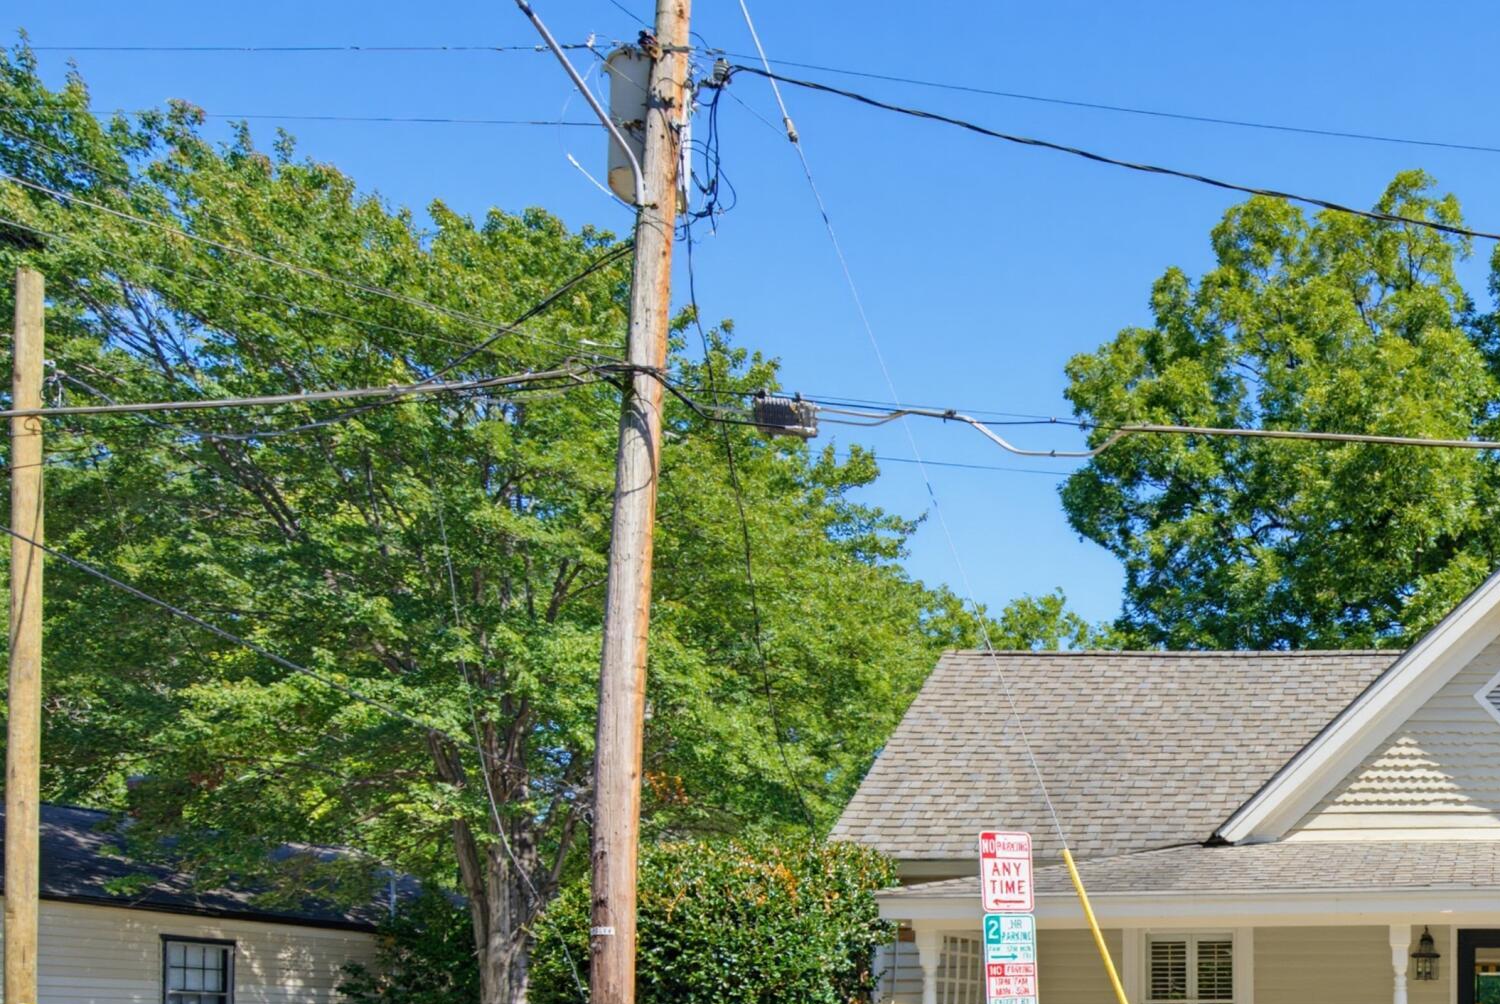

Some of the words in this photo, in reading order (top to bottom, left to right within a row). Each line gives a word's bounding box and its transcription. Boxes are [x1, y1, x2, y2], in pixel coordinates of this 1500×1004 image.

[982, 839, 996, 854] NO
[997, 841, 1028, 852] PARKING
[992, 862, 1021, 876] ANY
[990, 880, 1025, 894] TIME
[988, 920, 999, 939] 2
[989, 965, 1003, 976] NO
